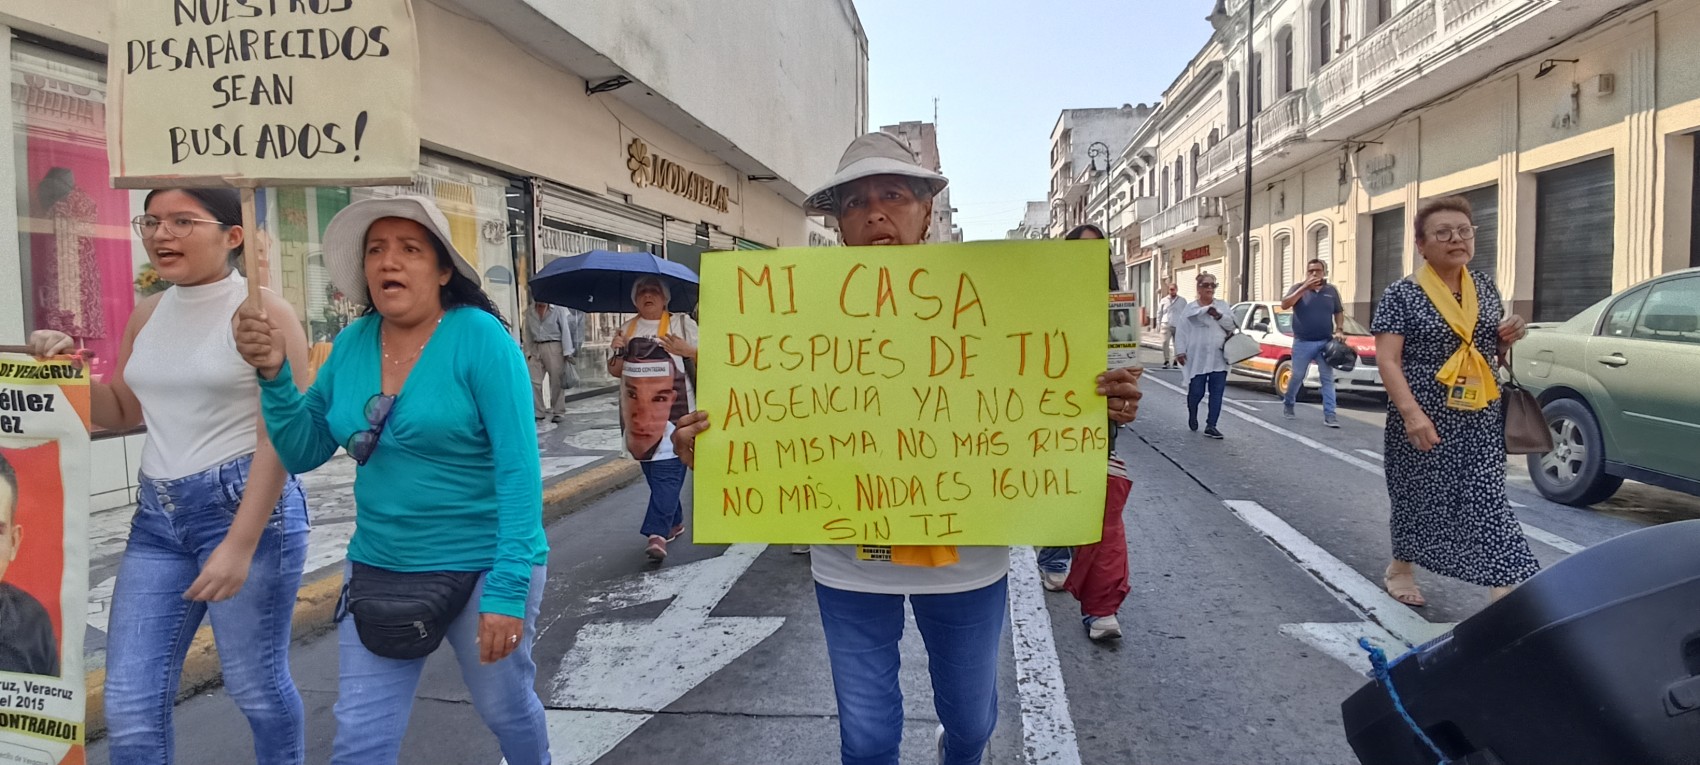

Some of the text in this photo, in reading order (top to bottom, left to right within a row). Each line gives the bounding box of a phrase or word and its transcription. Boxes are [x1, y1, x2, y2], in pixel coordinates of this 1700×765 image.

[126, 26, 391, 75] DESAPARECIDOS
[212, 74, 293, 109] SEAN
[169, 110, 369, 164] BUSCADOS!
[650, 154, 729, 213] MODATELAS
[737, 263, 987, 329] MI CASA
[0, 363, 83, 379] DE VERACRUZ
[724, 329, 1070, 379] DESPUÉS DE TÚ
[0, 388, 54, 412] éllez
[722, 383, 1082, 431] AUSENCIA YA NO ES
[0, 415, 24, 434] ez
[728, 440, 759, 476] LA
[897, 428, 937, 460] NO
[953, 427, 1010, 458] MÁS
[1028, 426, 1107, 457] RISAS
[723, 487, 764, 516] NO
[856, 474, 927, 512] NADA
[936, 472, 972, 502] ES
[822, 512, 963, 541] SIN TI
[15, 696, 45, 710] 2015
[24, 681, 73, 700] Veracruz
